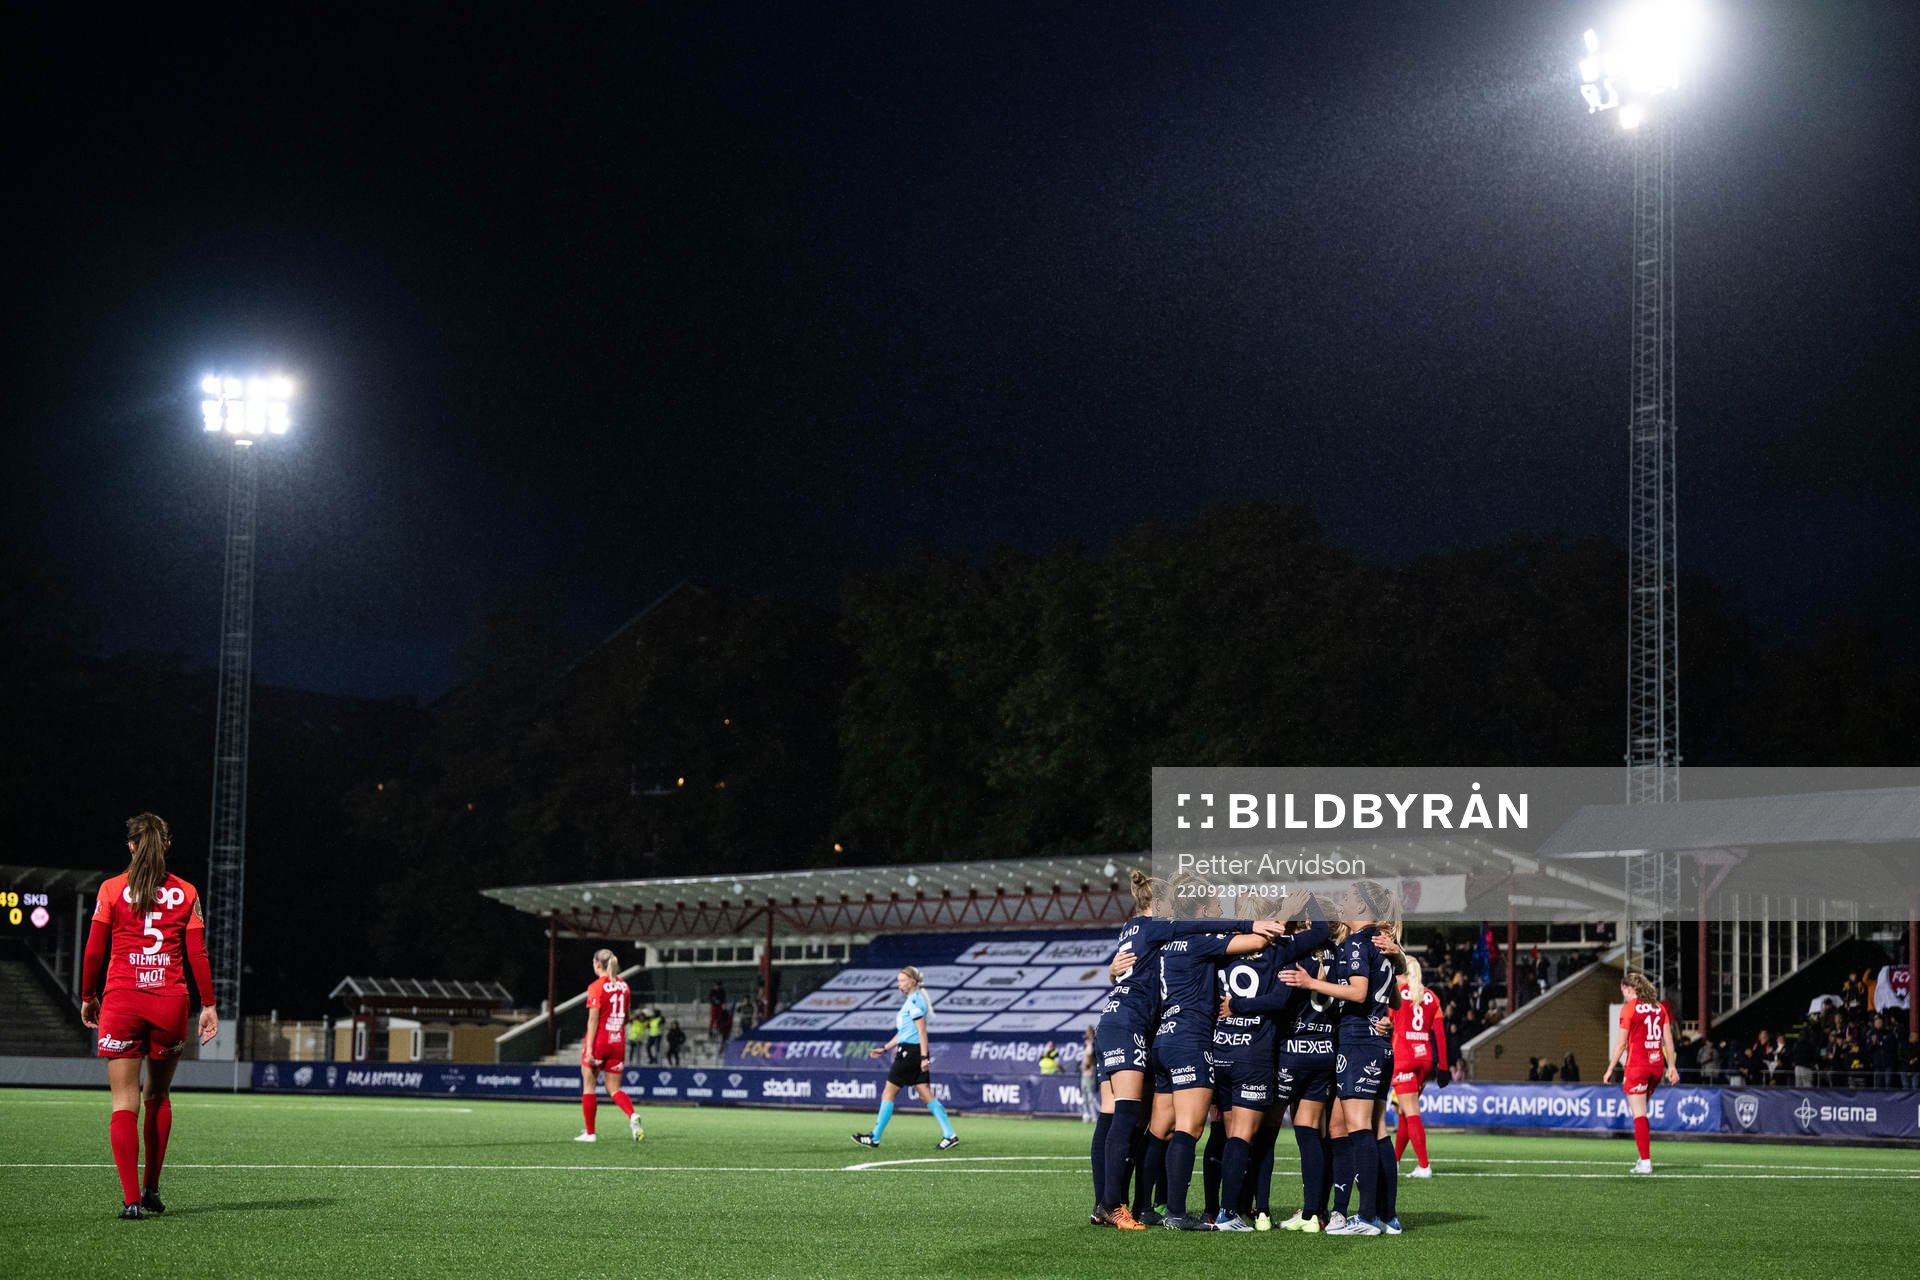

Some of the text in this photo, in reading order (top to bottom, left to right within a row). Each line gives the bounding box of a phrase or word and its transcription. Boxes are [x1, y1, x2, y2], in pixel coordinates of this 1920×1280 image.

[9, 907, 23, 925] 0
[142, 911, 164, 955] 5
[609, 993, 626, 1018] 11
[1411, 1005, 1424, 1031] 8
[1644, 1015, 1662, 1041] 16
[1287, 1039, 1334, 1054] NEXER
[1170, 1065, 1195, 1074] Scandic
[763, 1078, 811, 1097] stadium
[826, 1080, 877, 1099] stadium
[982, 1084, 1020, 1104] RWE
[1241, 1083, 1267, 1091] Scandic
[1482, 1096, 1591, 1117] CHAMPIONS
[1596, 1097, 1665, 1118] LEAUE
